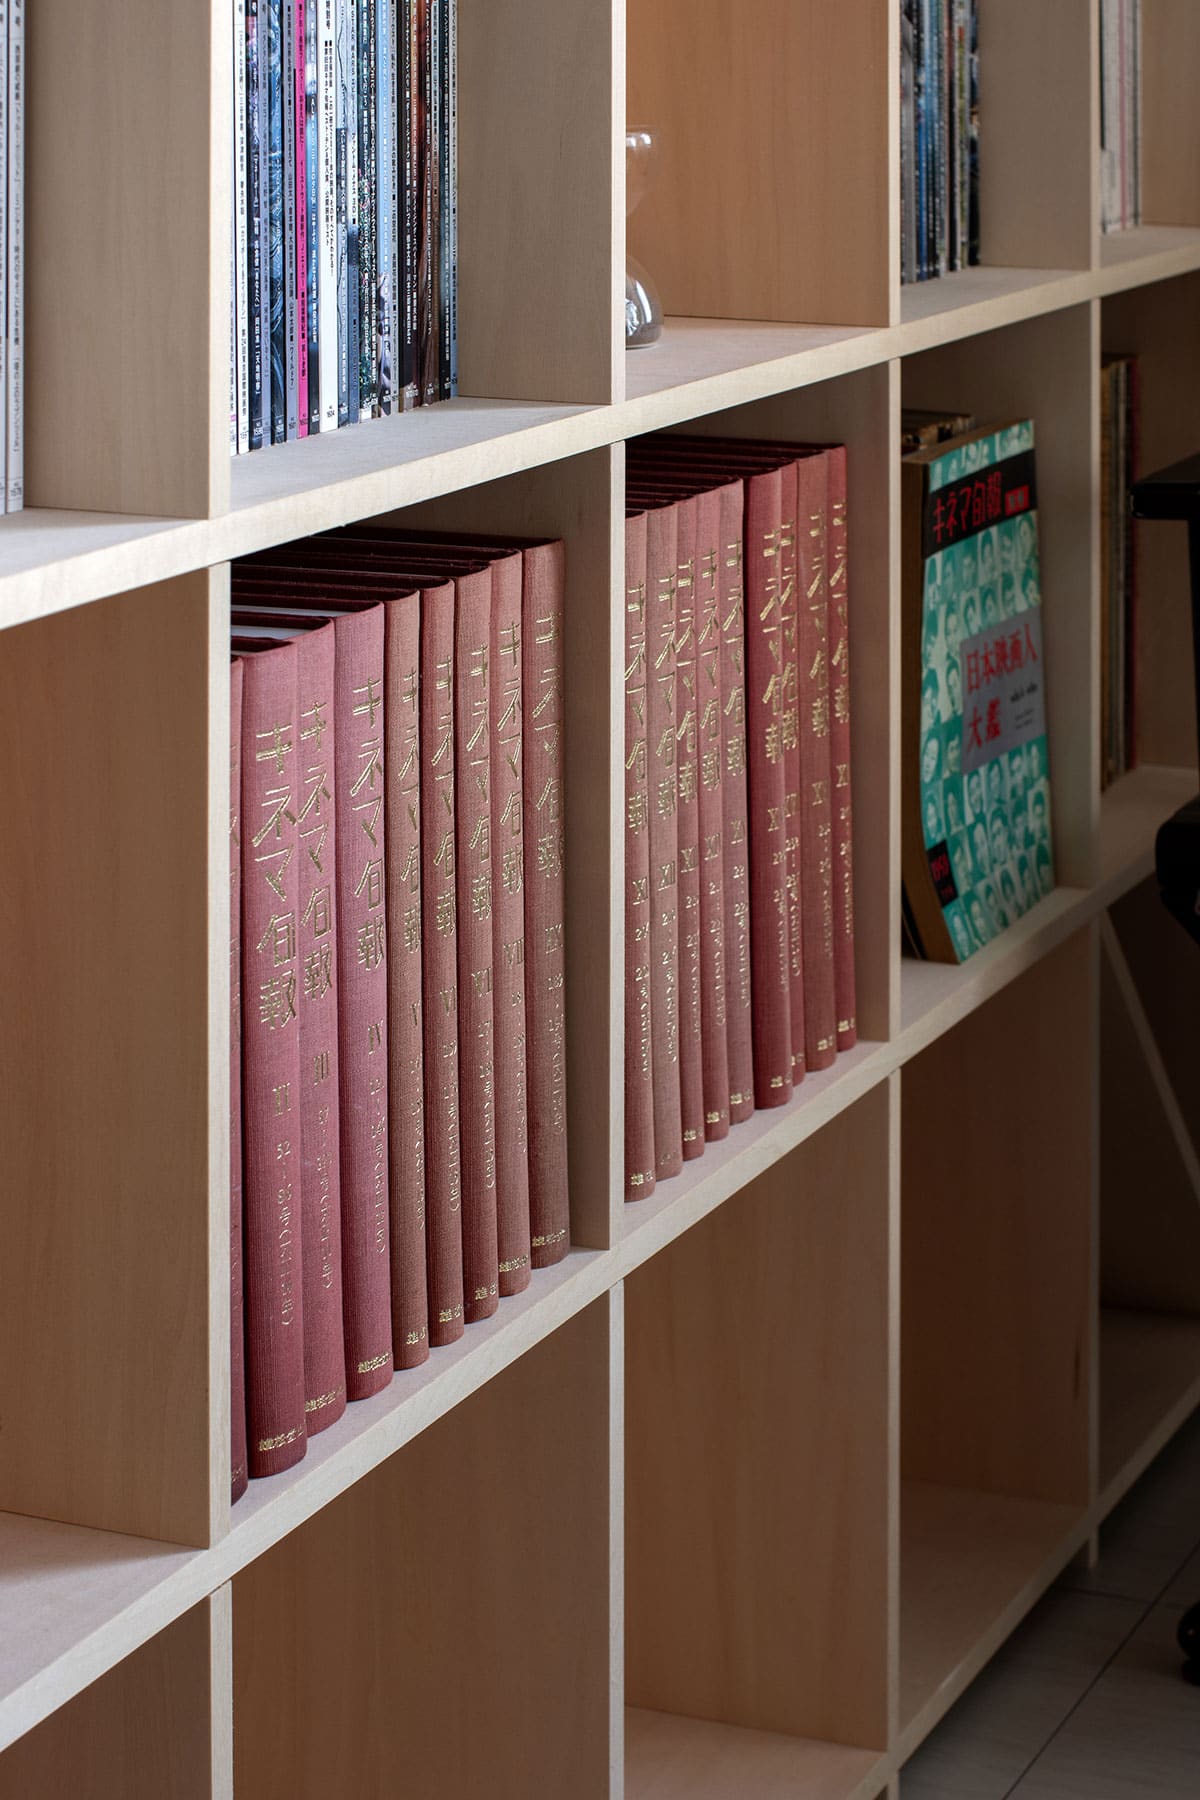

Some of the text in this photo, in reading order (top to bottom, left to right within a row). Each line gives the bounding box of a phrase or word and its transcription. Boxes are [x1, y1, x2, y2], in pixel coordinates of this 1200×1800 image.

[931, 470, 1002, 545] キネマ旬報
[967, 623, 1039, 696] 日本映画人
[252, 721, 297, 1030] キネマ旬報
[298, 702, 334, 1001] キネマ旬報
[351, 677, 385, 971] キネマ旬報
